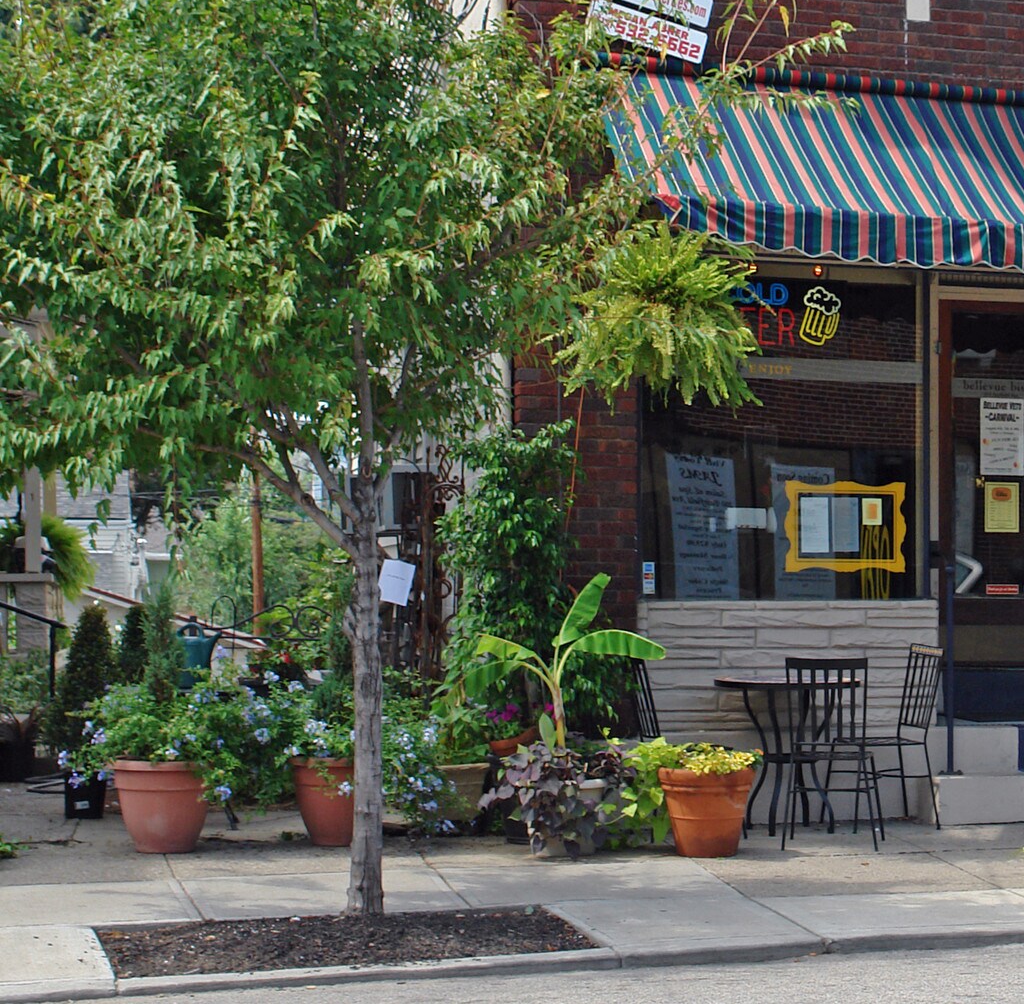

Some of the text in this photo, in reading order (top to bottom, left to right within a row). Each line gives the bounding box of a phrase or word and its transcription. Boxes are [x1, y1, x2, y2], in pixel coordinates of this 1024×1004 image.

[734, 282, 789, 306] OLD
[739, 307, 796, 346] ER
[749, 362, 793, 375] ENJOY
[962, 379, 1007, 391] bellevue
